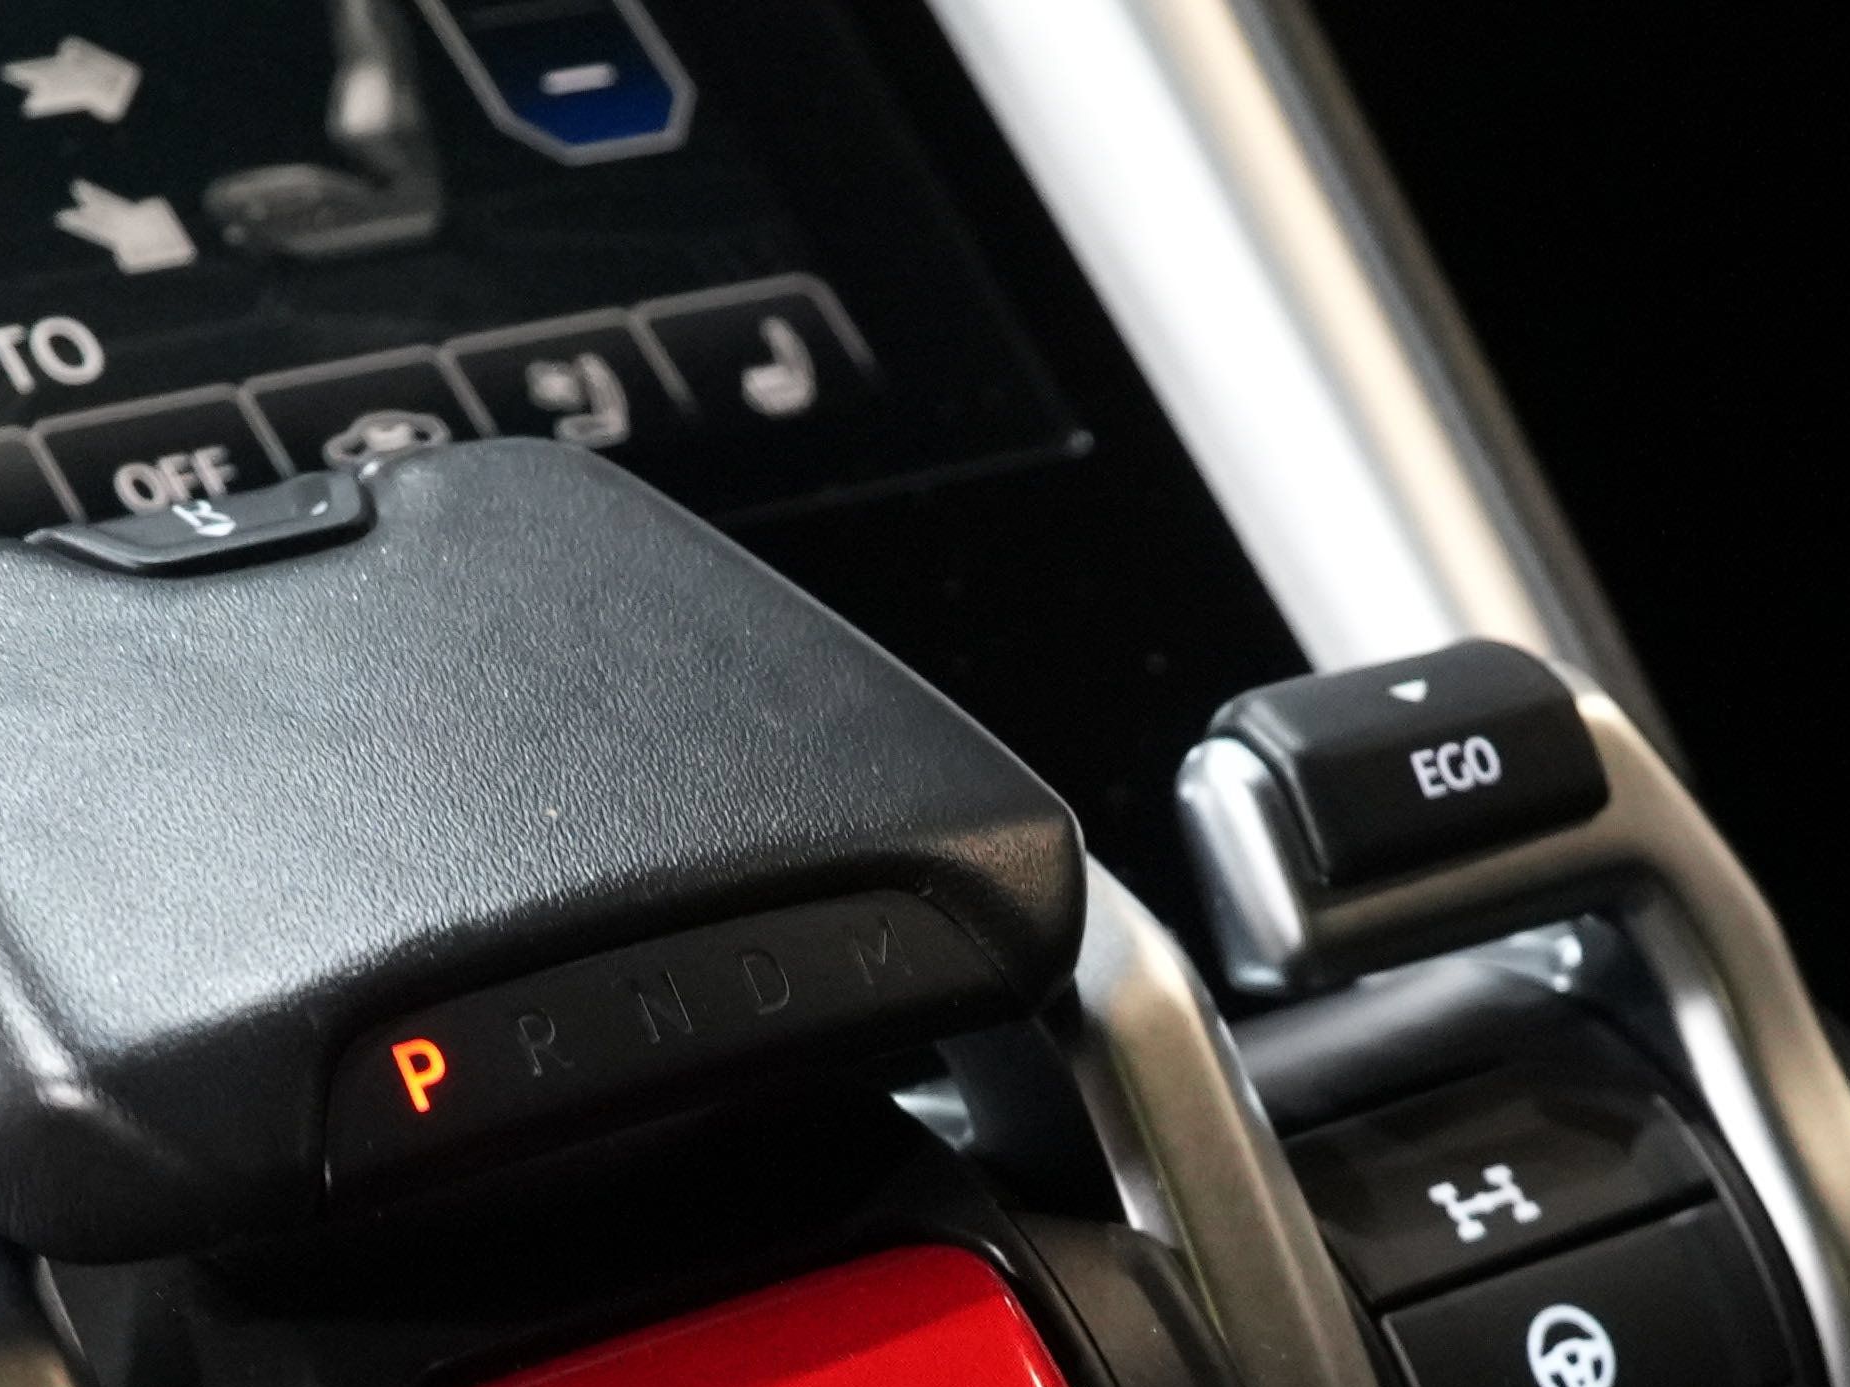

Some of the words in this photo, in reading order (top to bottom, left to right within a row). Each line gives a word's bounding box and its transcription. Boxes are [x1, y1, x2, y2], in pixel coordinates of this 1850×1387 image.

[112, 445, 238, 515] OFF
[1409, 735, 1502, 800] EGO
[390, 1037, 448, 1113] P
[513, 1006, 575, 1078] R
[628, 968, 694, 1045] N
[736, 948, 791, 1016] D
